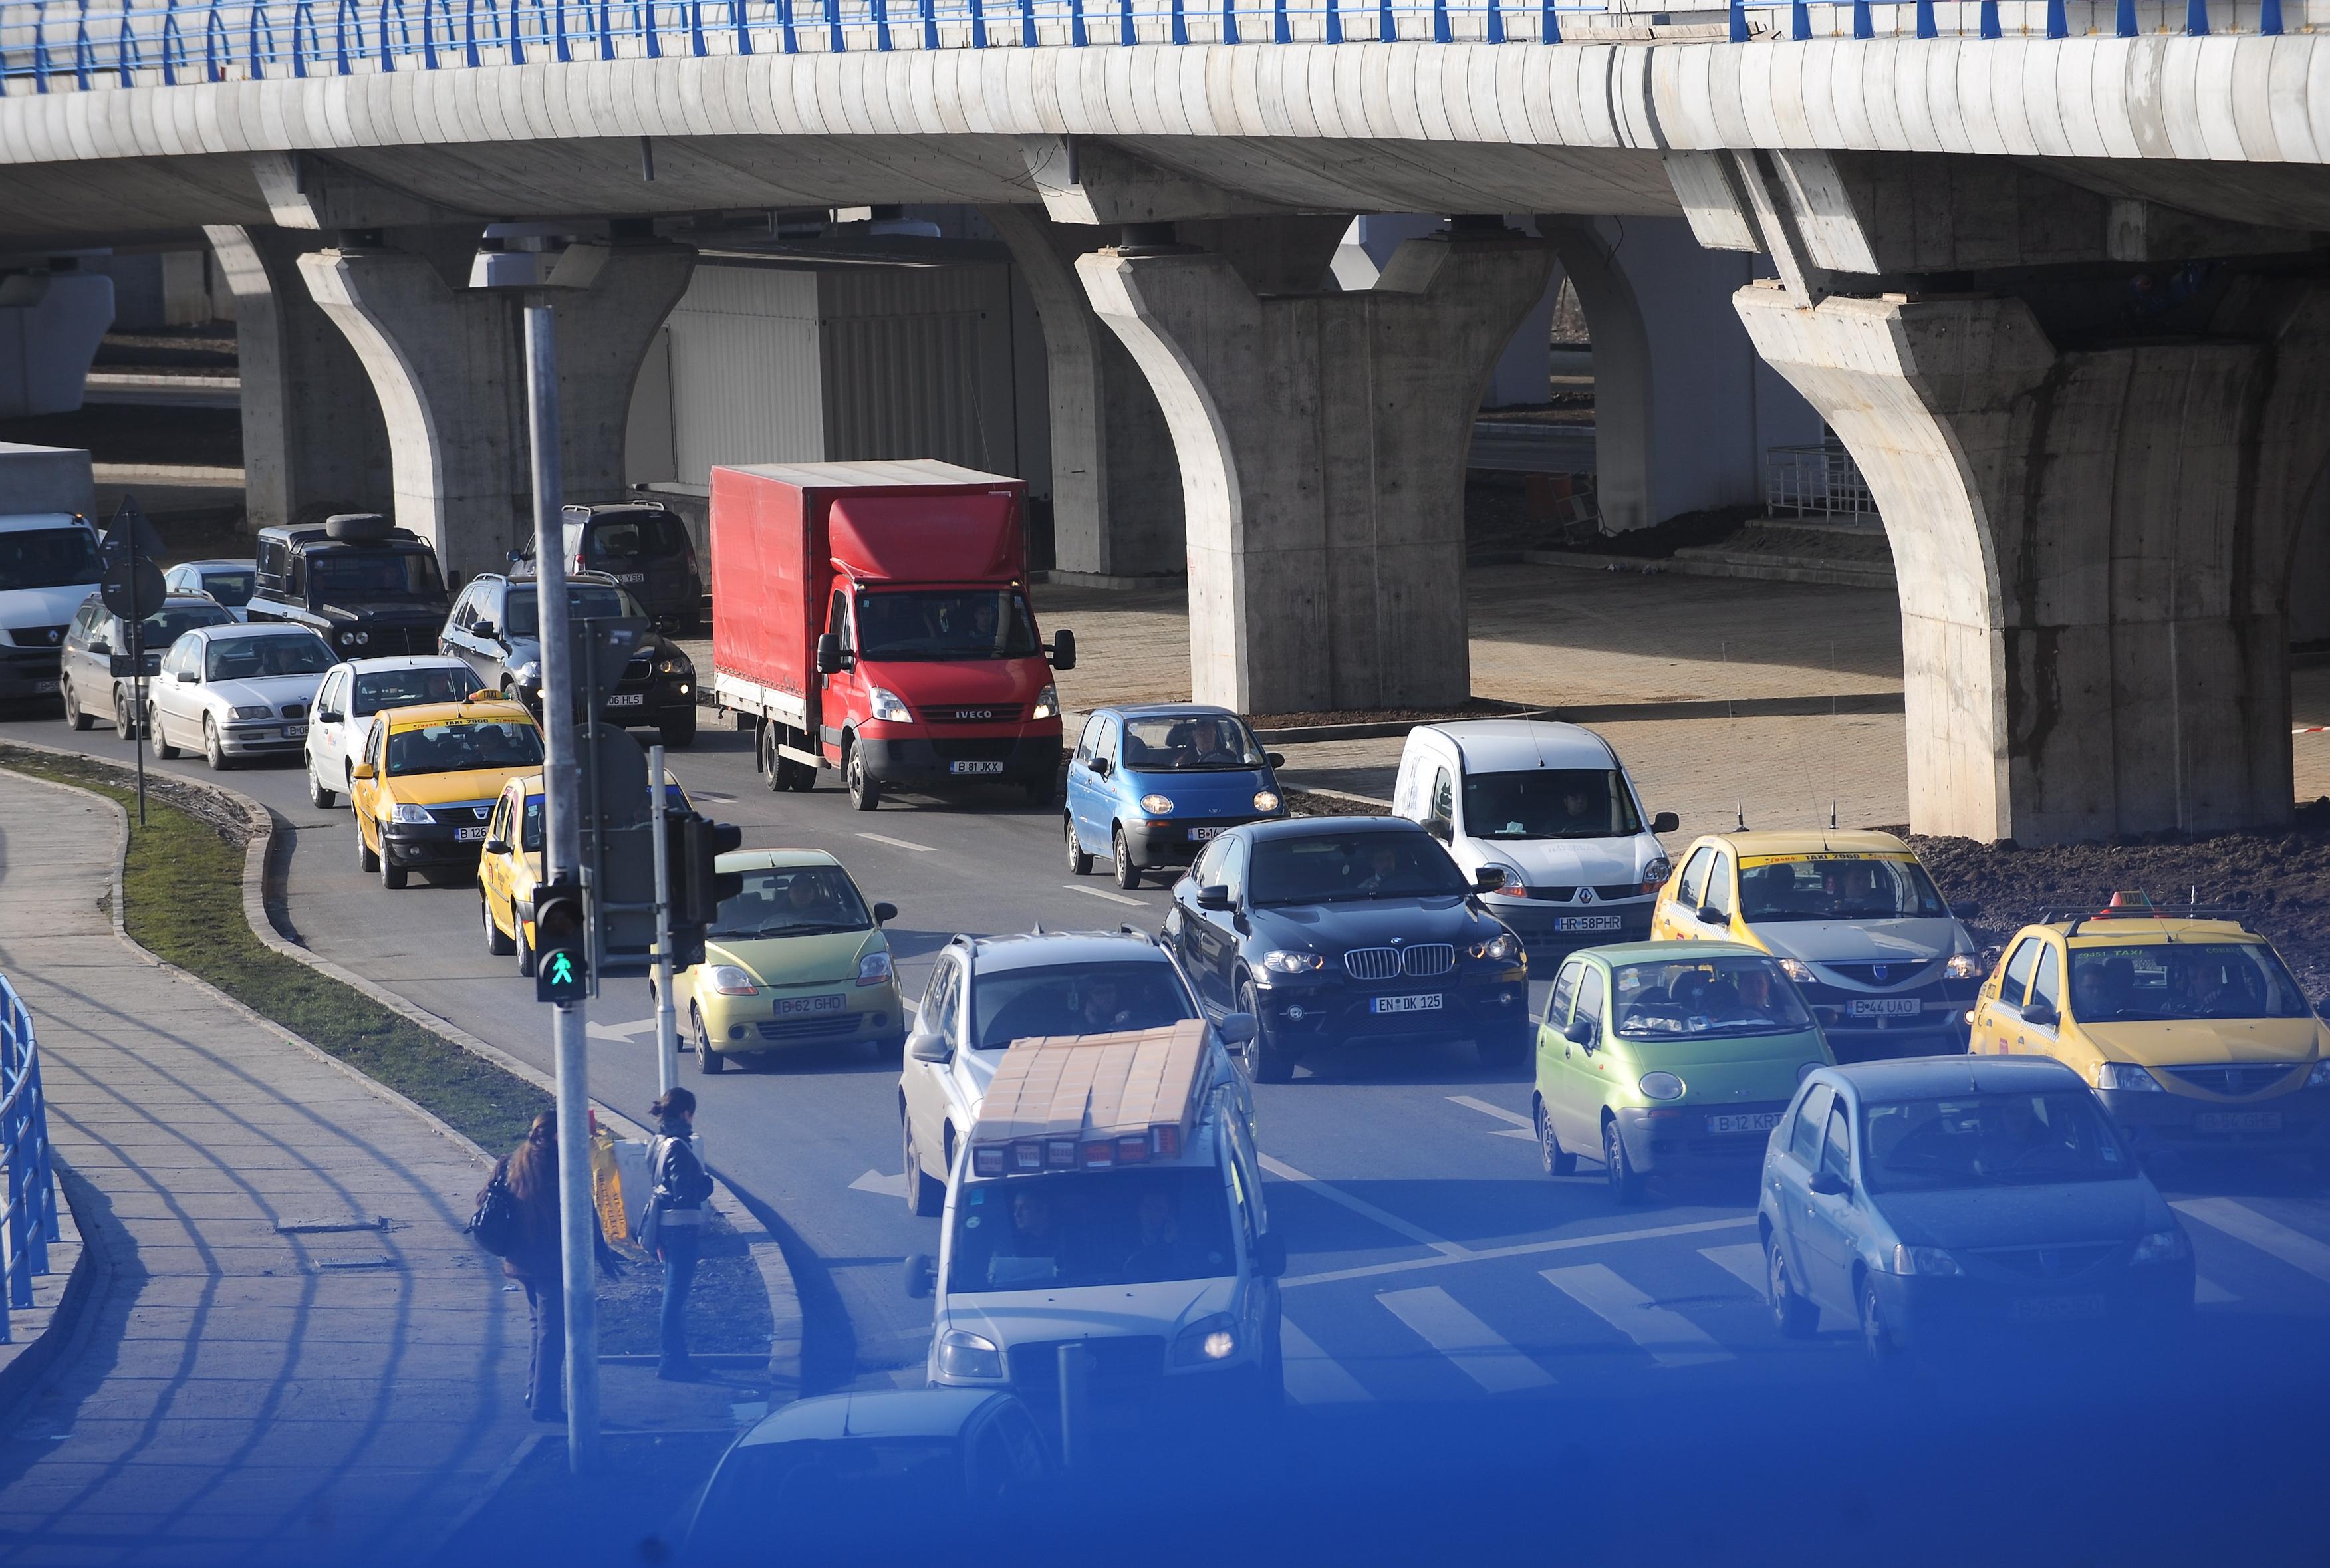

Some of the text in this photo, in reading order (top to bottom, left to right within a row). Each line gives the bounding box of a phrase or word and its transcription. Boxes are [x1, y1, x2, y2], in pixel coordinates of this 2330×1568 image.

[483, 690, 497, 699] TAXI
[622, 696, 640, 704] HLS
[958, 762, 999, 771] B 81 JKX
[460, 827, 487, 839] B 126
[1198, 829, 1206, 839] B
[2123, 892, 2142, 905] TAXI
[1560, 918, 1577, 930] HR
[782, 997, 841, 1013] B 62 GHD
[1379, 995, 1440, 1011] EN DK 125
[1856, 1000, 1912, 1013] B 44 UAO
[1720, 1117, 1729, 1131] B
[1735, 1116, 1749, 1130] 12
